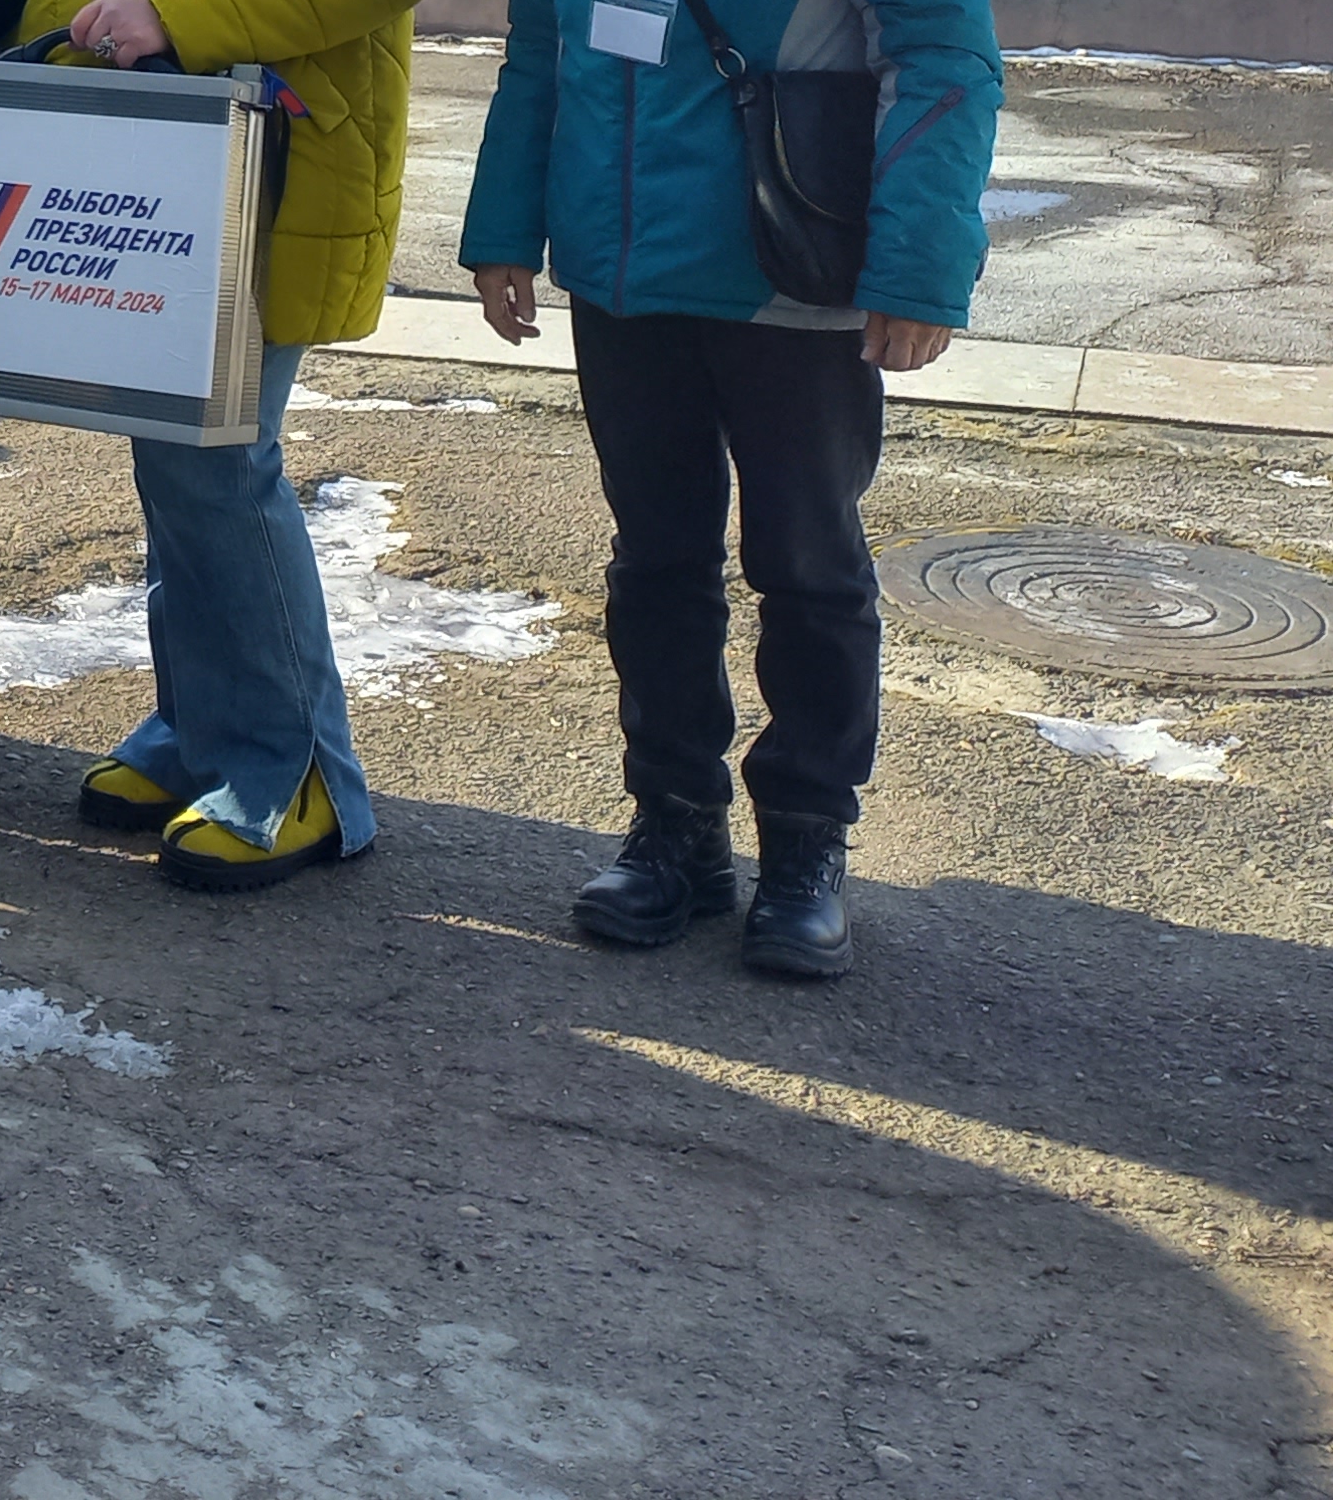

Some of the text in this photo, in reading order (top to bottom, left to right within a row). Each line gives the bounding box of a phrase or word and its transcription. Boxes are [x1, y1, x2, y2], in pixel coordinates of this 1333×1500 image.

[40, 187, 163, 220] ВЫБОРЫ
[24, 218, 195, 257] ПРЕЗИДЕНТА
[9, 247, 119, 281] РОССИИ
[49, 283, 116, 310] МАРТА
[116, 291, 166, 315] 2024
